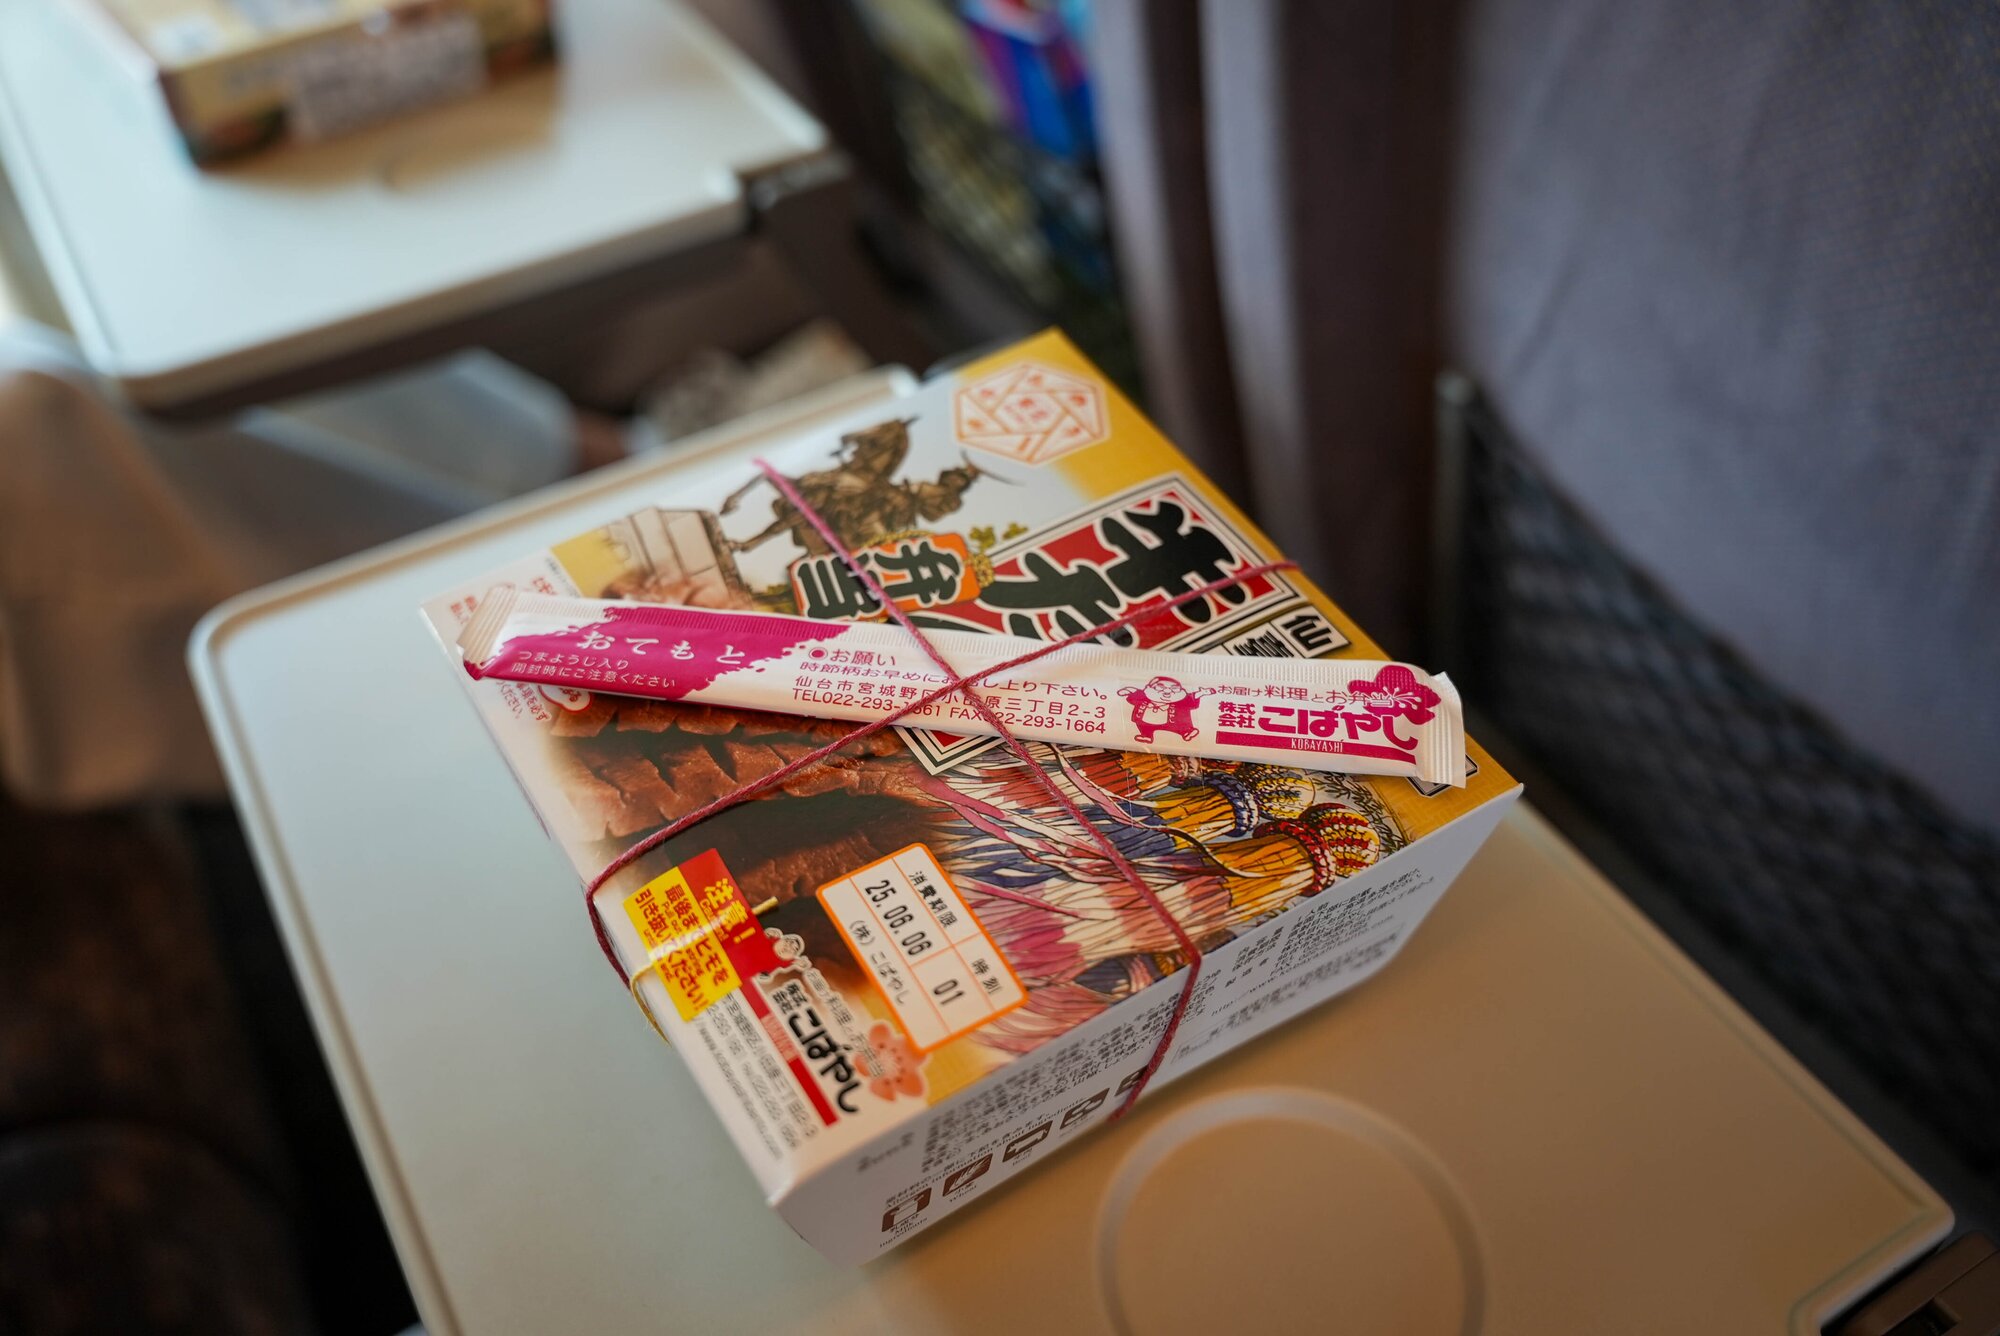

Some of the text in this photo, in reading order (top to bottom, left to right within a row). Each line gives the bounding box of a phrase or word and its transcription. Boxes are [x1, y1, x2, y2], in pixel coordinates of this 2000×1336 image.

[798, 541, 960, 619] 弁当
[903, 500, 1246, 648] 牛た
[517, 650, 629, 670] つまようじ入り
[577, 630, 745, 665] おてもと
[830, 649, 896, 666] お願い
[511, 662, 676, 688] 開封時にご注意ください
[800, 661, 1107, 700] 時節柄お早めにおし上り下さい。
[949, 707, 1106, 734] FAX22-293-1664
[1258, 705, 1418, 751] こばやし
[1291, 738, 1344, 753] KOBAYASHI
[909, 871, 957, 929] 消費期限
[699, 897, 730, 942] Cauon!
[933, 978, 966, 1007] 01
[972, 958, 1002, 996] 時刻
[788, 1006, 860, 1113] こばやし
